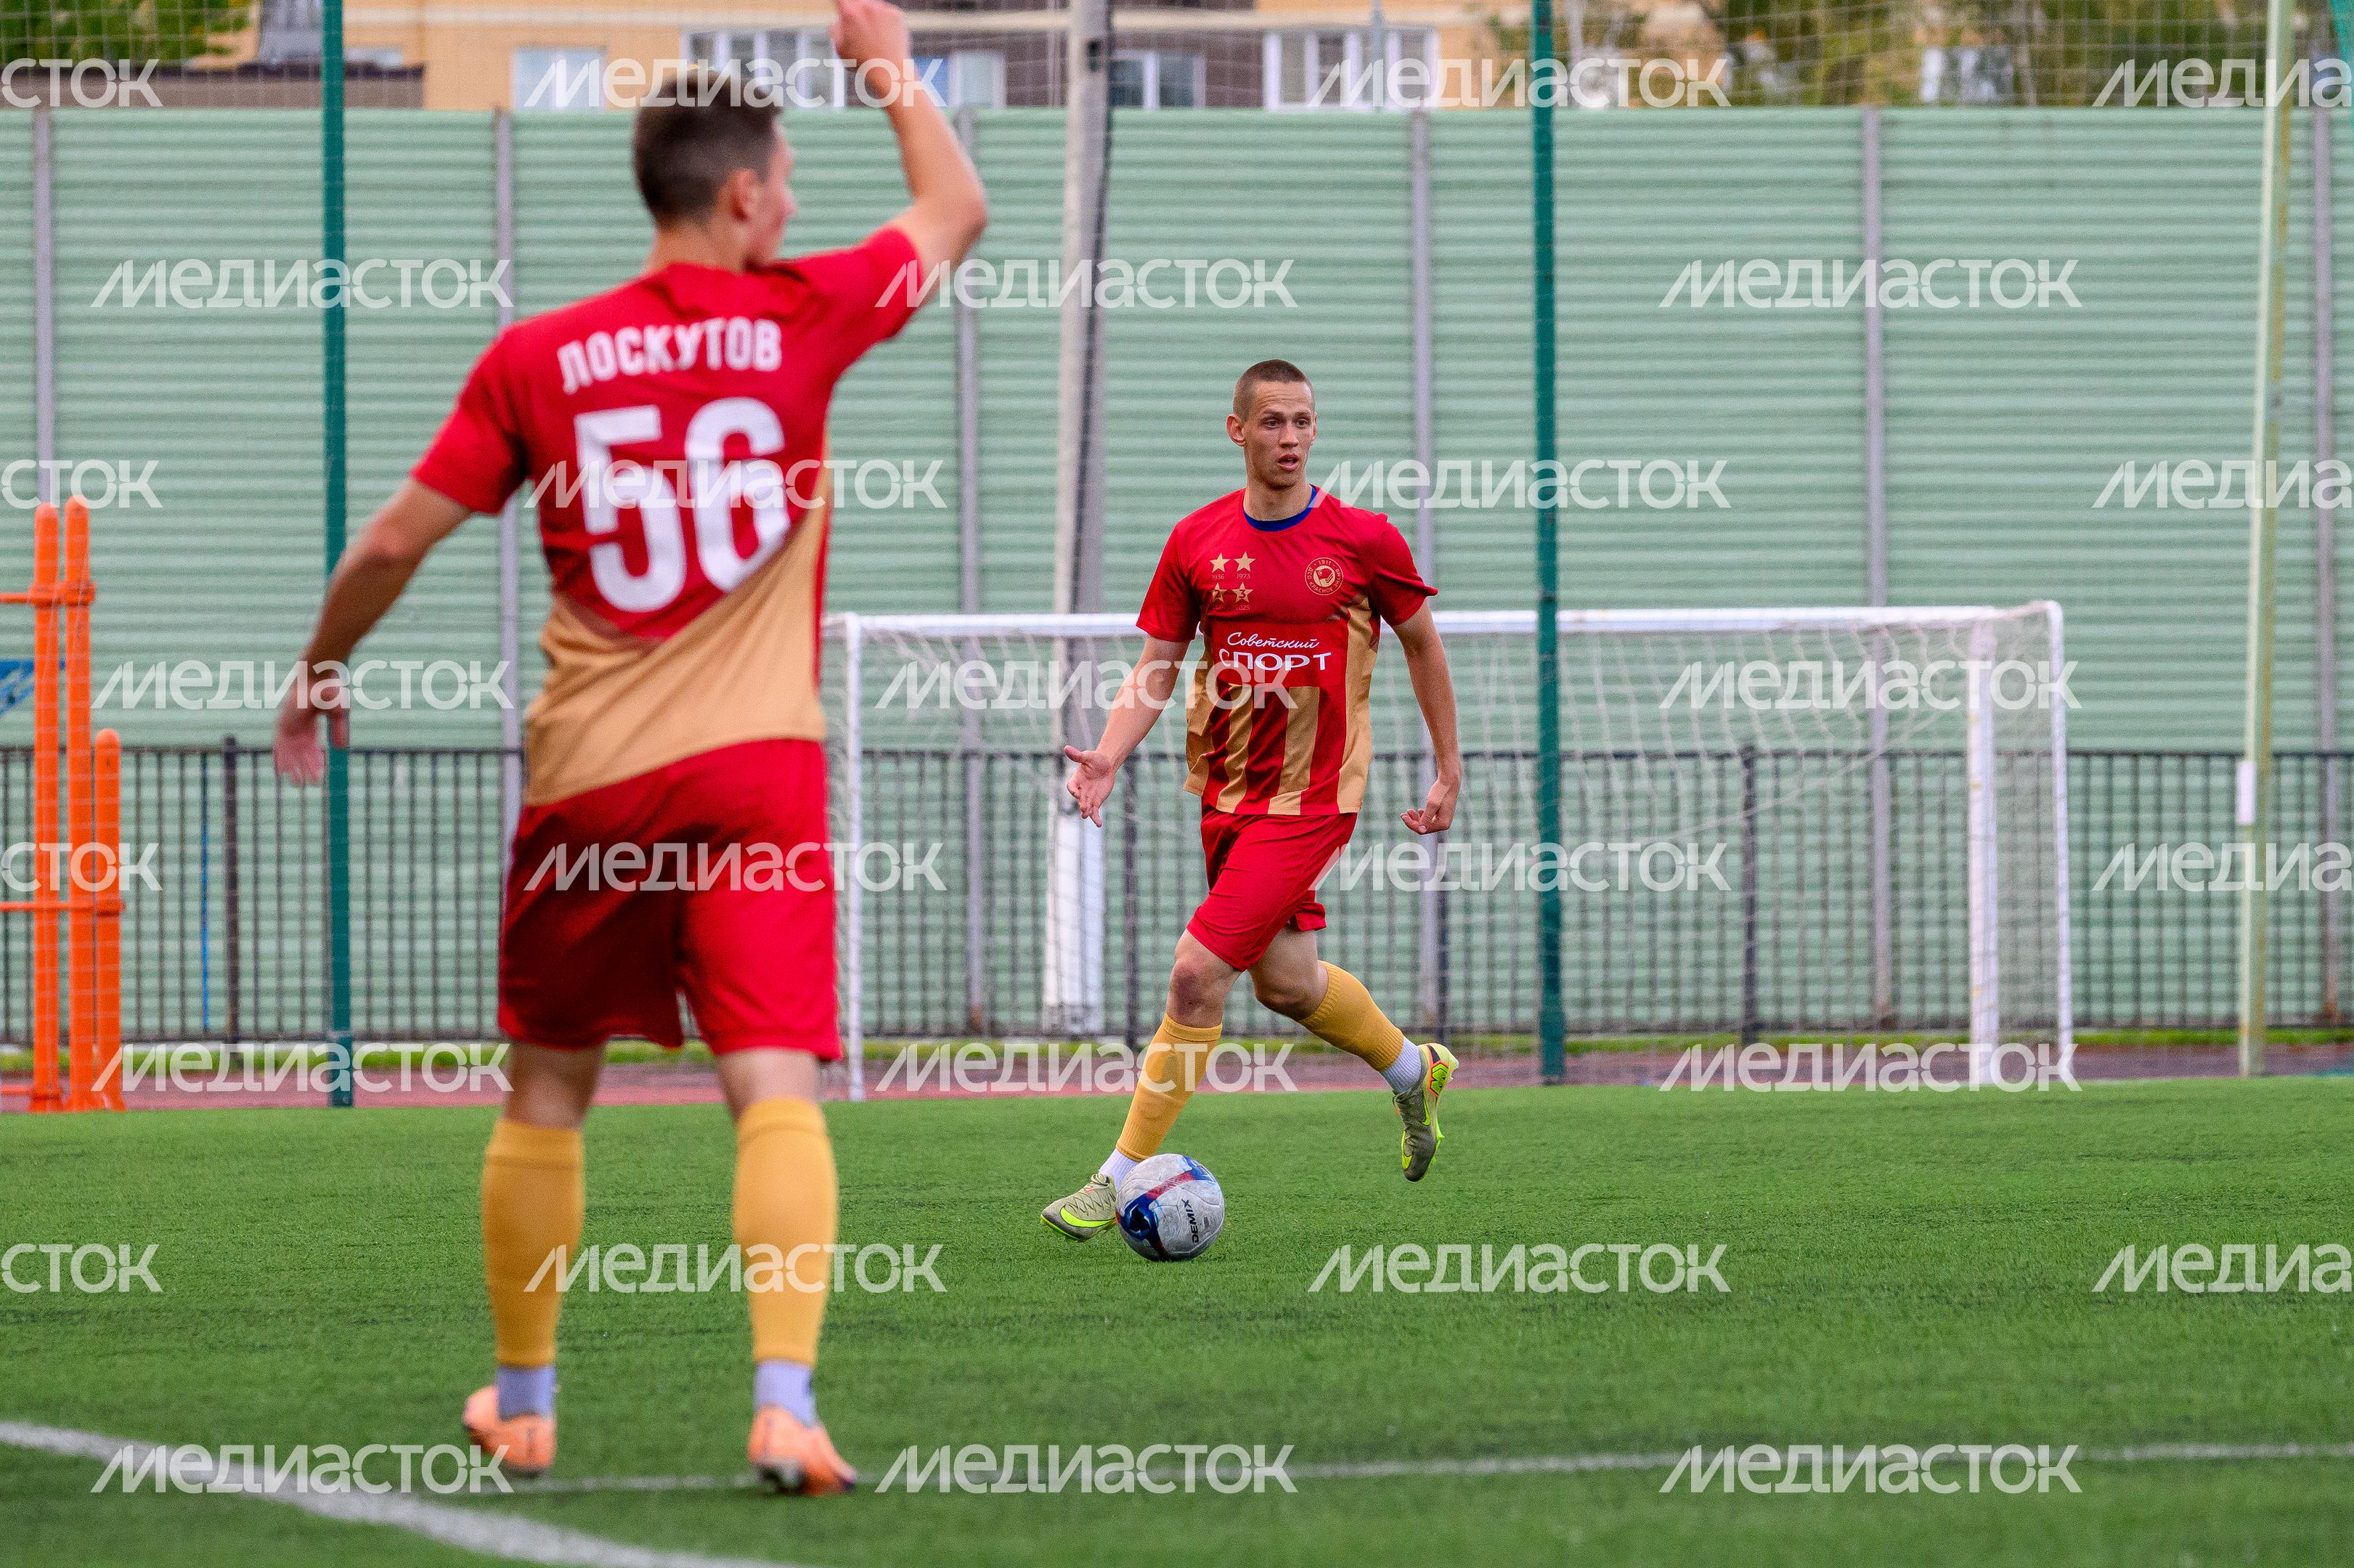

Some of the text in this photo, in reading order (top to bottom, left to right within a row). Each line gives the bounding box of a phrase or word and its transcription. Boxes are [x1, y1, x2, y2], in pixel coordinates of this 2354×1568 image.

[556, 317, 783, 394] ЛОСКУТОВ
[574, 396, 791, 613] 56
[1309, 581, 1333, 593] КРАСНОЕ
[1227, 632, 1320, 648] Советский
[1218, 648, 1332, 671] СПОРТ
[1181, 1199, 1200, 1244] DEMIX
